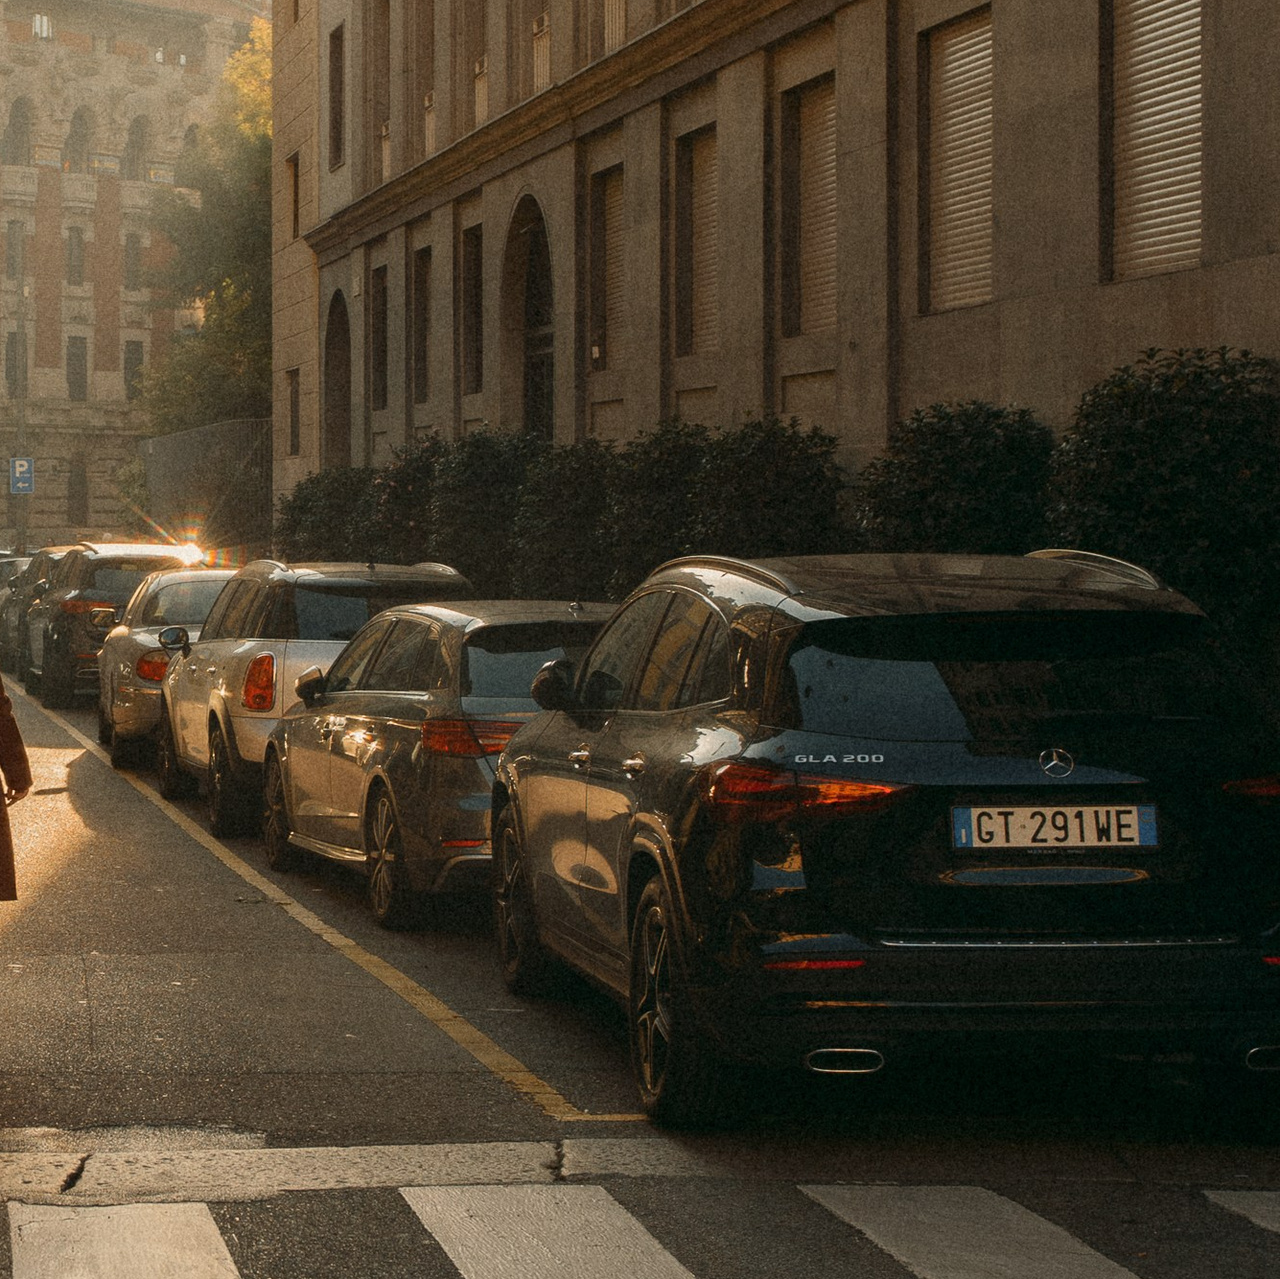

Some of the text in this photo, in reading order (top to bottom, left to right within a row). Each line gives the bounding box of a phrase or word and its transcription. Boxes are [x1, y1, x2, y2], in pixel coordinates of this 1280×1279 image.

[15, 460, 28, 477] P
[794, 754, 884, 763] GLA 200
[976, 809, 1135, 844] GT 291WE
